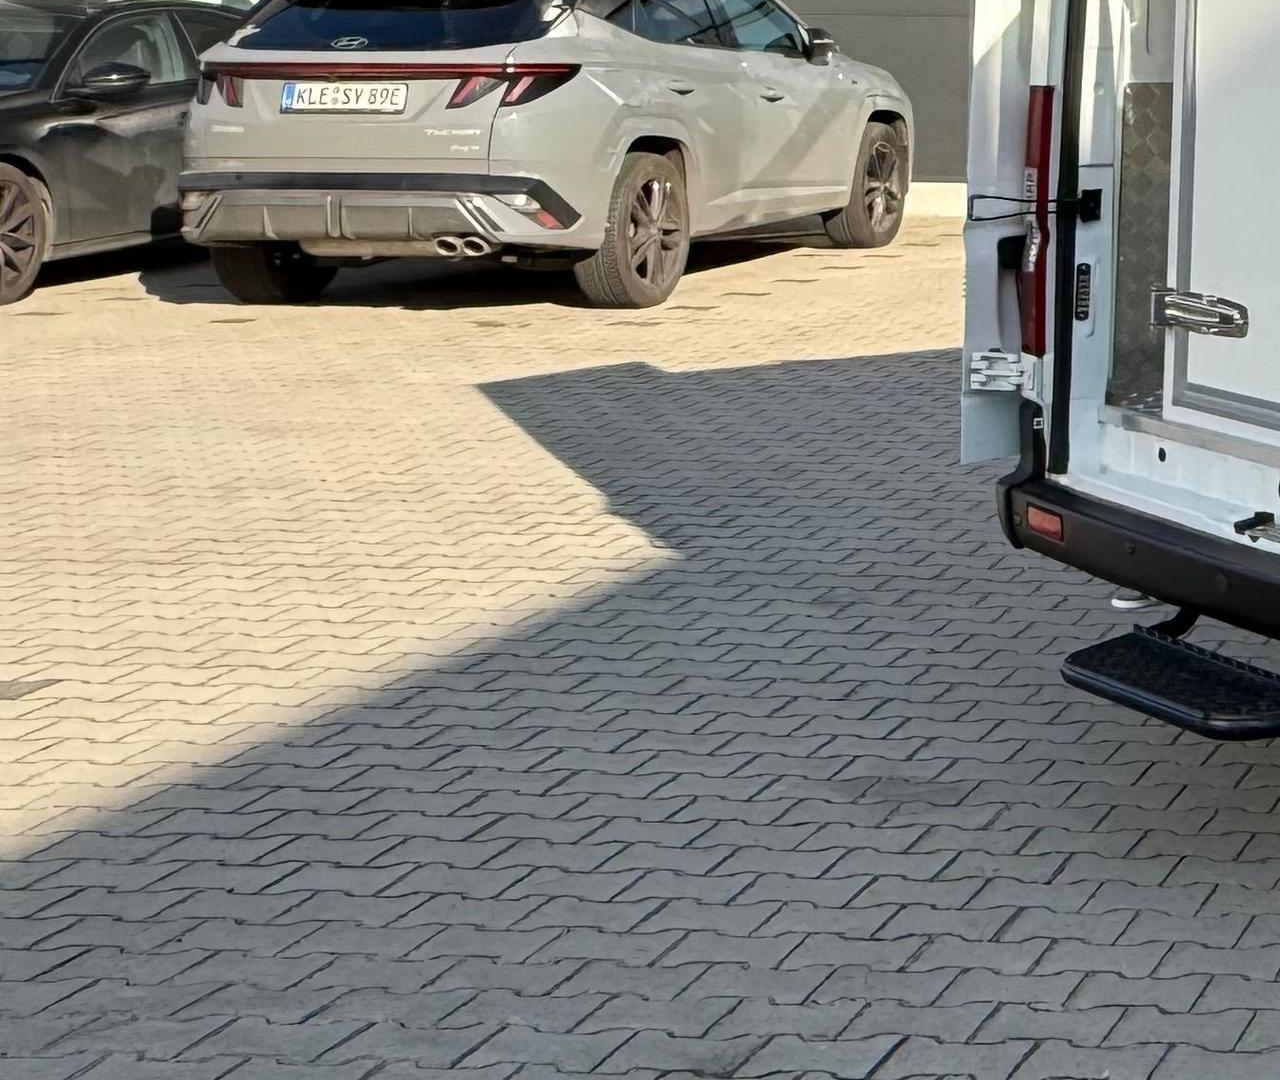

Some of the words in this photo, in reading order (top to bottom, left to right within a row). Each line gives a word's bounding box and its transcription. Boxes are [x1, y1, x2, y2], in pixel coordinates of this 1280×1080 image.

[296, 87, 329, 106] KLE
[342, 87, 364, 105] SY
[368, 87, 401, 106] 89E
